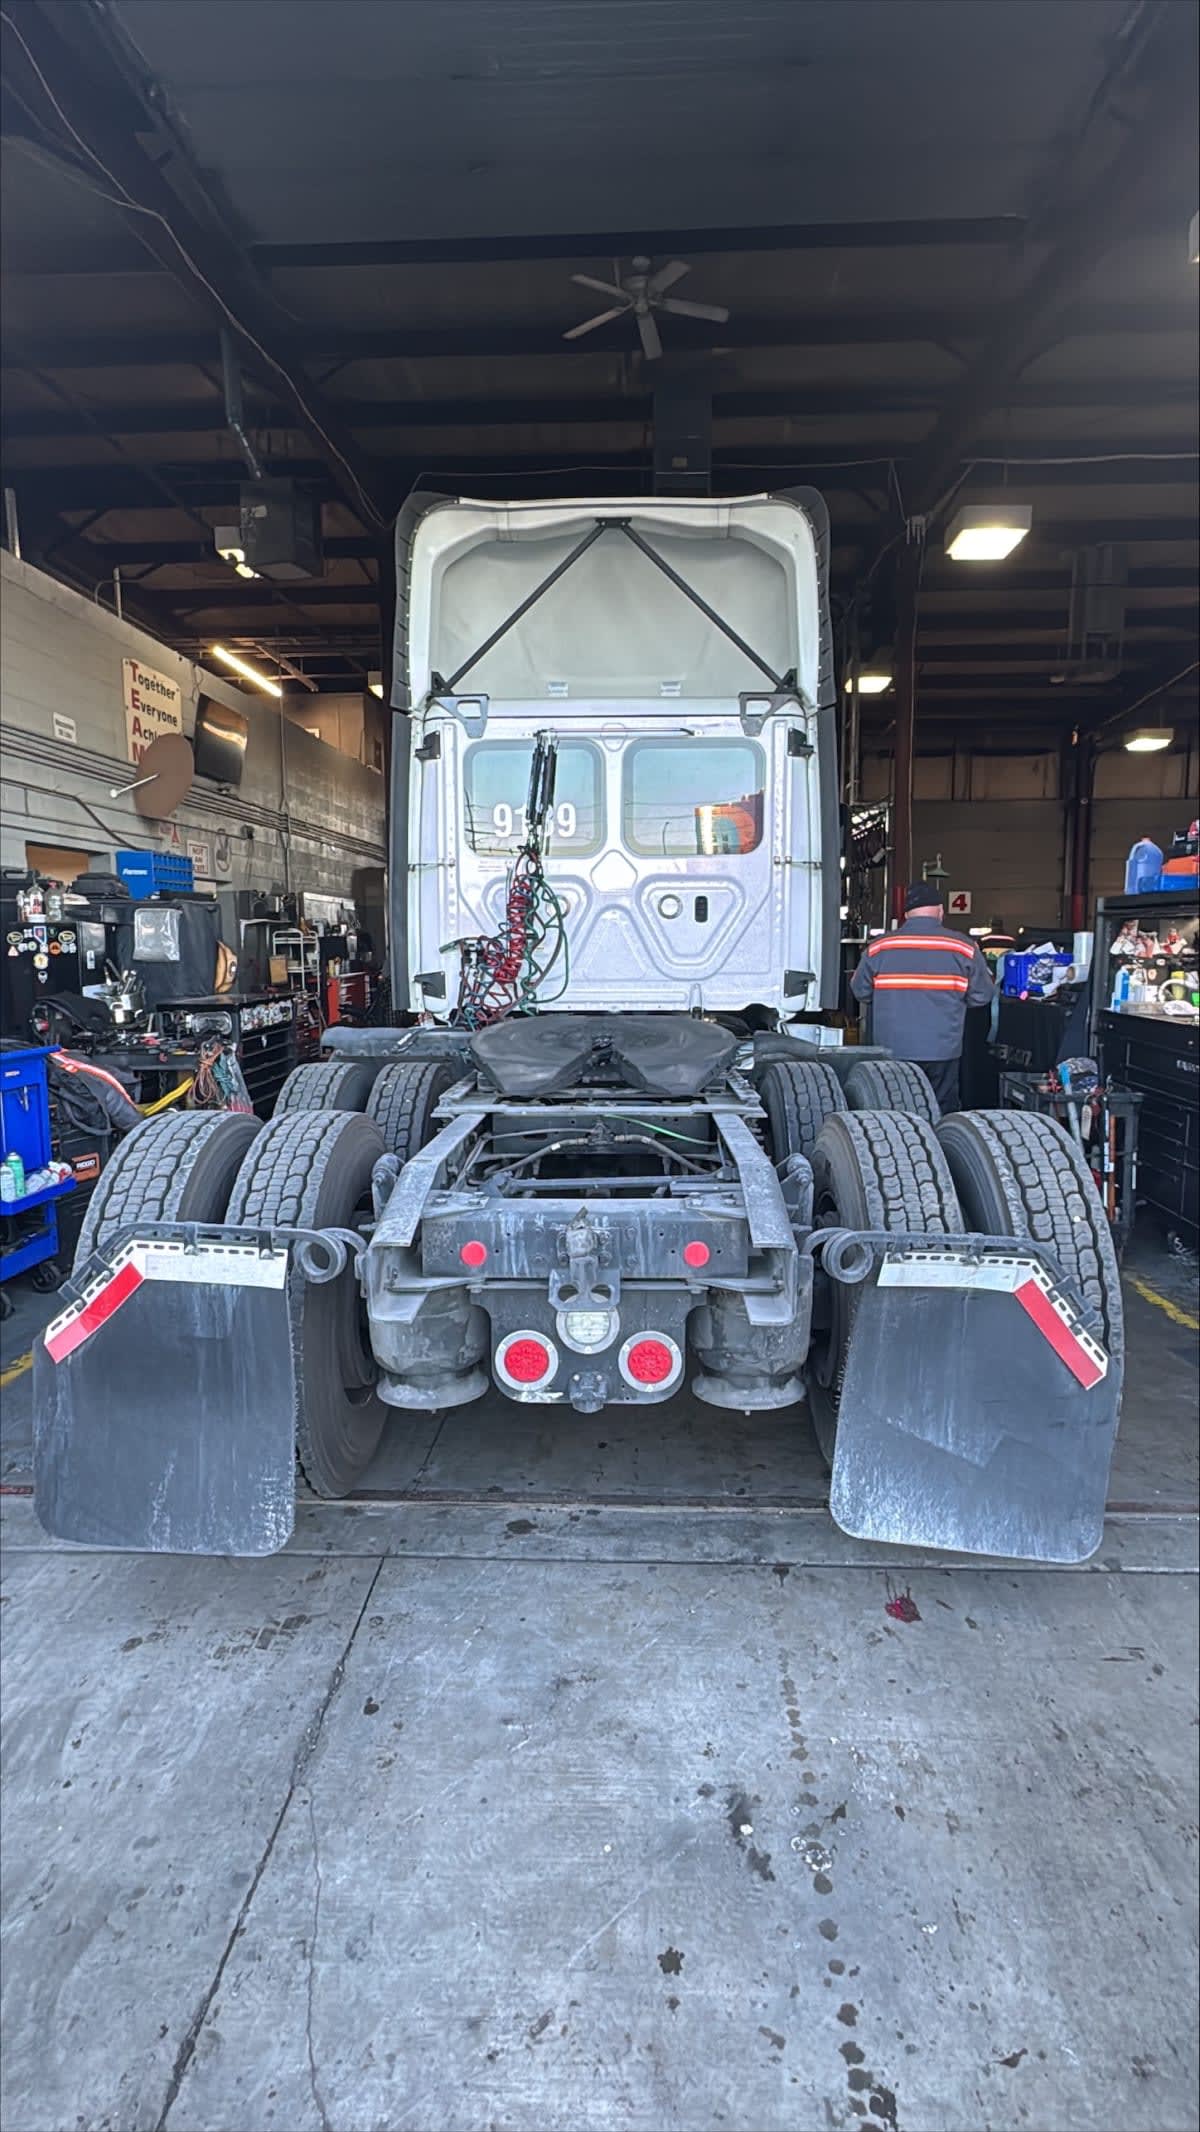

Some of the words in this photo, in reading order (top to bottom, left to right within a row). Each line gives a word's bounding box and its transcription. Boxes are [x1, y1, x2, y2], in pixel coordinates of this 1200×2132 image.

[129, 660, 176, 700] Together
[131, 688, 178, 727] Everyone
[951, 894, 967, 911] 4
